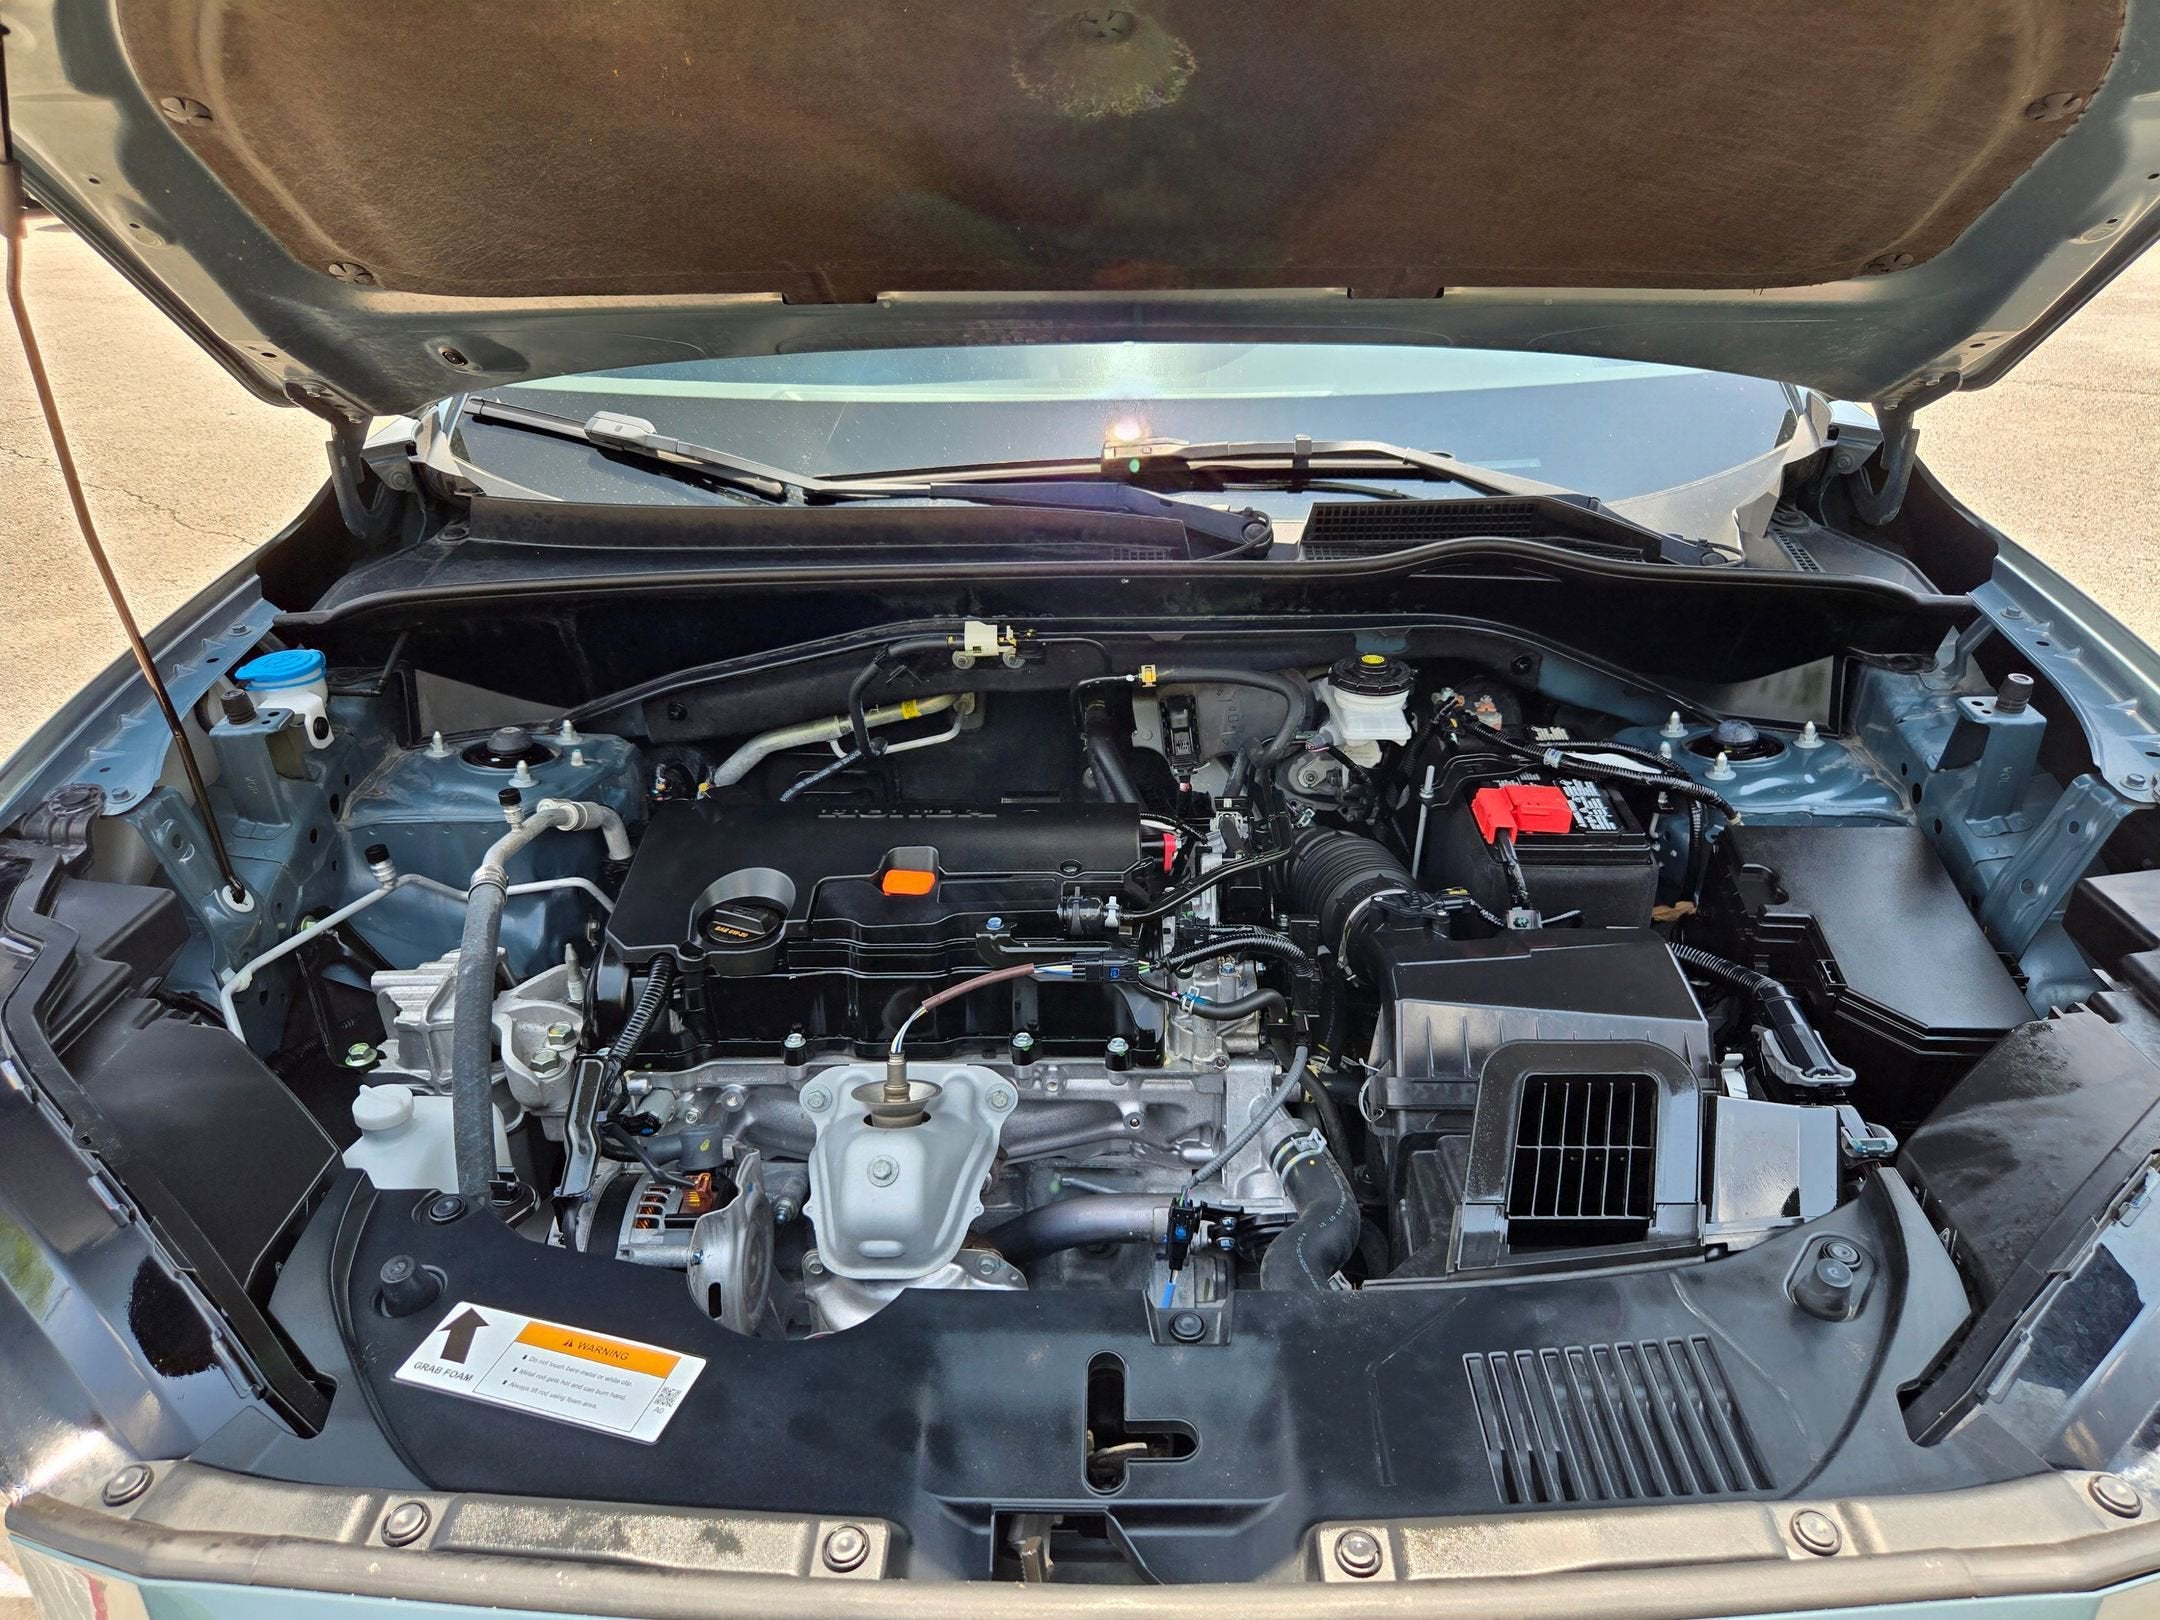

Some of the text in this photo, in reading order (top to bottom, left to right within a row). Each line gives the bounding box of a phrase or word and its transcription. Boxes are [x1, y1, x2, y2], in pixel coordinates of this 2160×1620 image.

[577, 1341, 630, 1361] WARNING
[413, 1361, 474, 1382] GRAB FOAM
[528, 1355, 537, 1363] Do
[538, 1358, 548, 1366] not
[549, 1361, 565, 1370] touch
[565, 1365, 579, 1374] bare
[580, 1369, 597, 1378] metal
[604, 1375, 621, 1384] white
[509, 1381, 529, 1392] Always
[530, 1385, 538, 1393] lift
[538, 1388, 549, 1396] rod
[549, 1392, 566, 1402] using
[566, 1395, 582, 1405] foam
[518, 1368, 536, 1377] Metal
[536, 1372, 546, 1380] rod
[546, 1375, 560, 1384] gets
[561, 1378, 571, 1386] hot
[571, 1382, 583, 1390] and
[595, 1387, 610, 1396] burn
